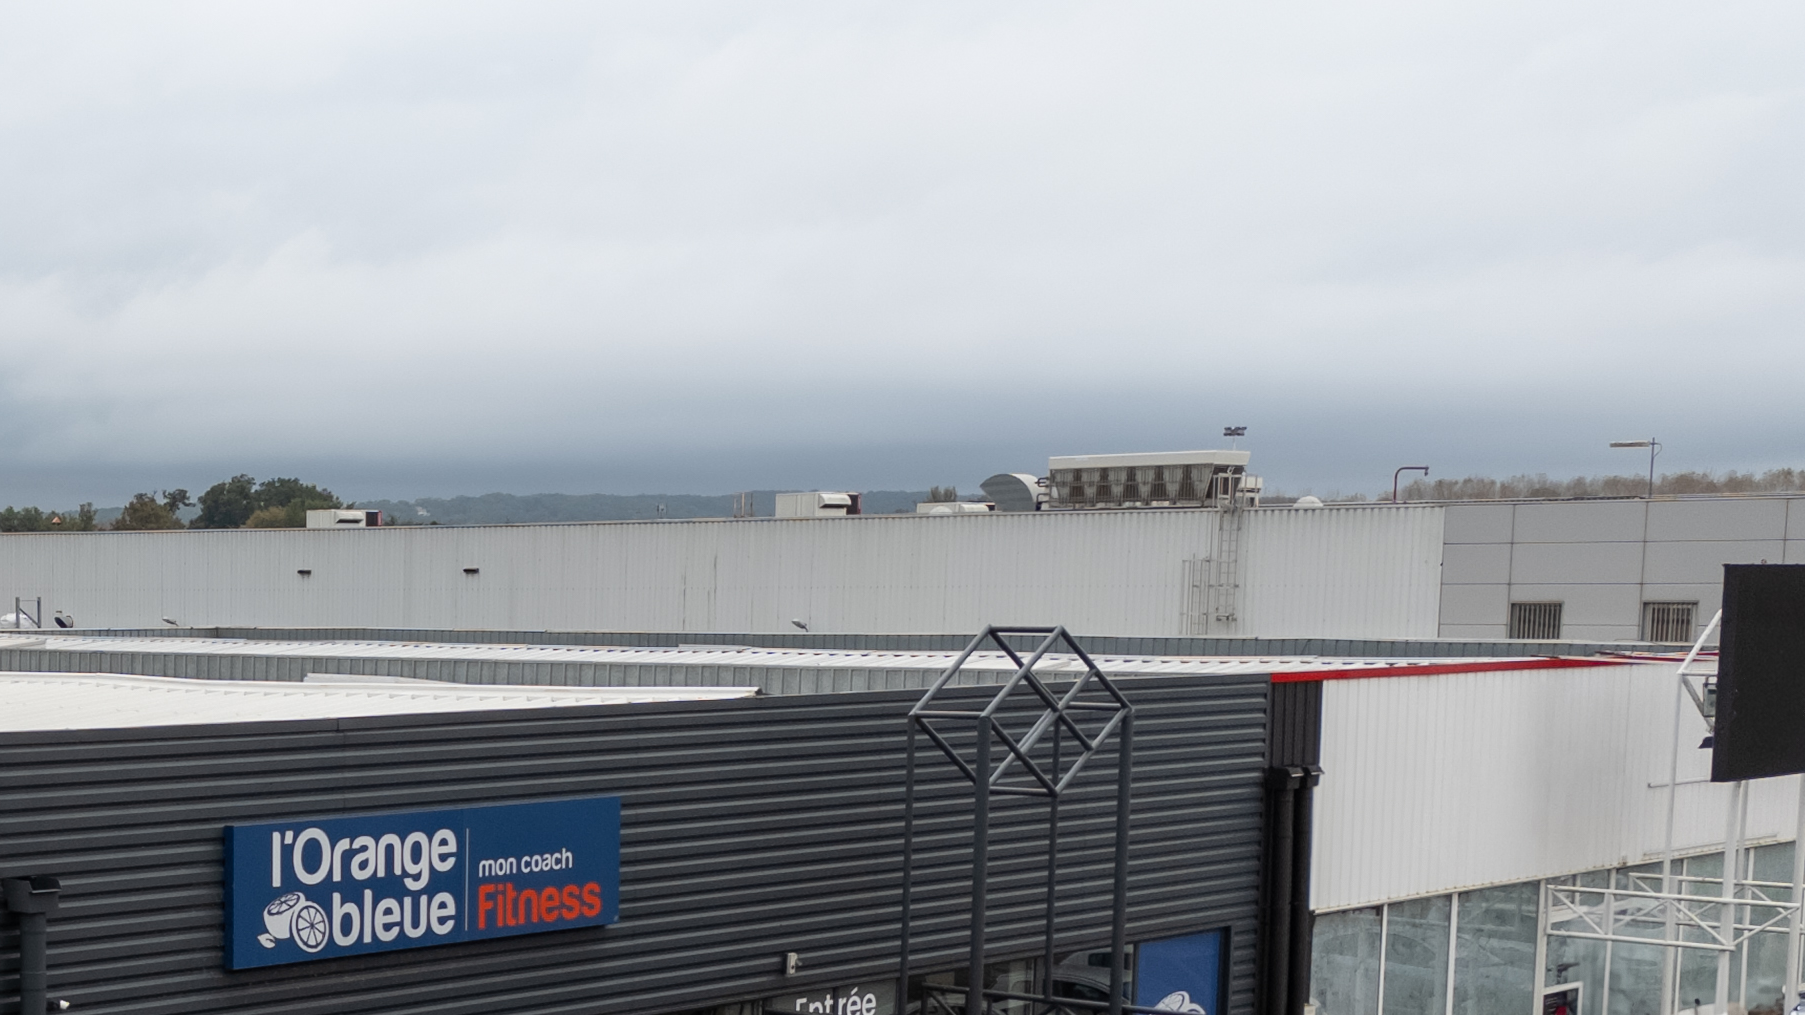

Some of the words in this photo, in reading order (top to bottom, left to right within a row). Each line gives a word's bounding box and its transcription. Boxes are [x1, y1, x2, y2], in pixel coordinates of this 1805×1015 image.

[271, 826, 458, 891] l'Orange
[479, 857, 517, 878] mon
[521, 848, 573, 873] coach
[332, 889, 457, 946] bleue
[477, 880, 602, 930] Fitness
